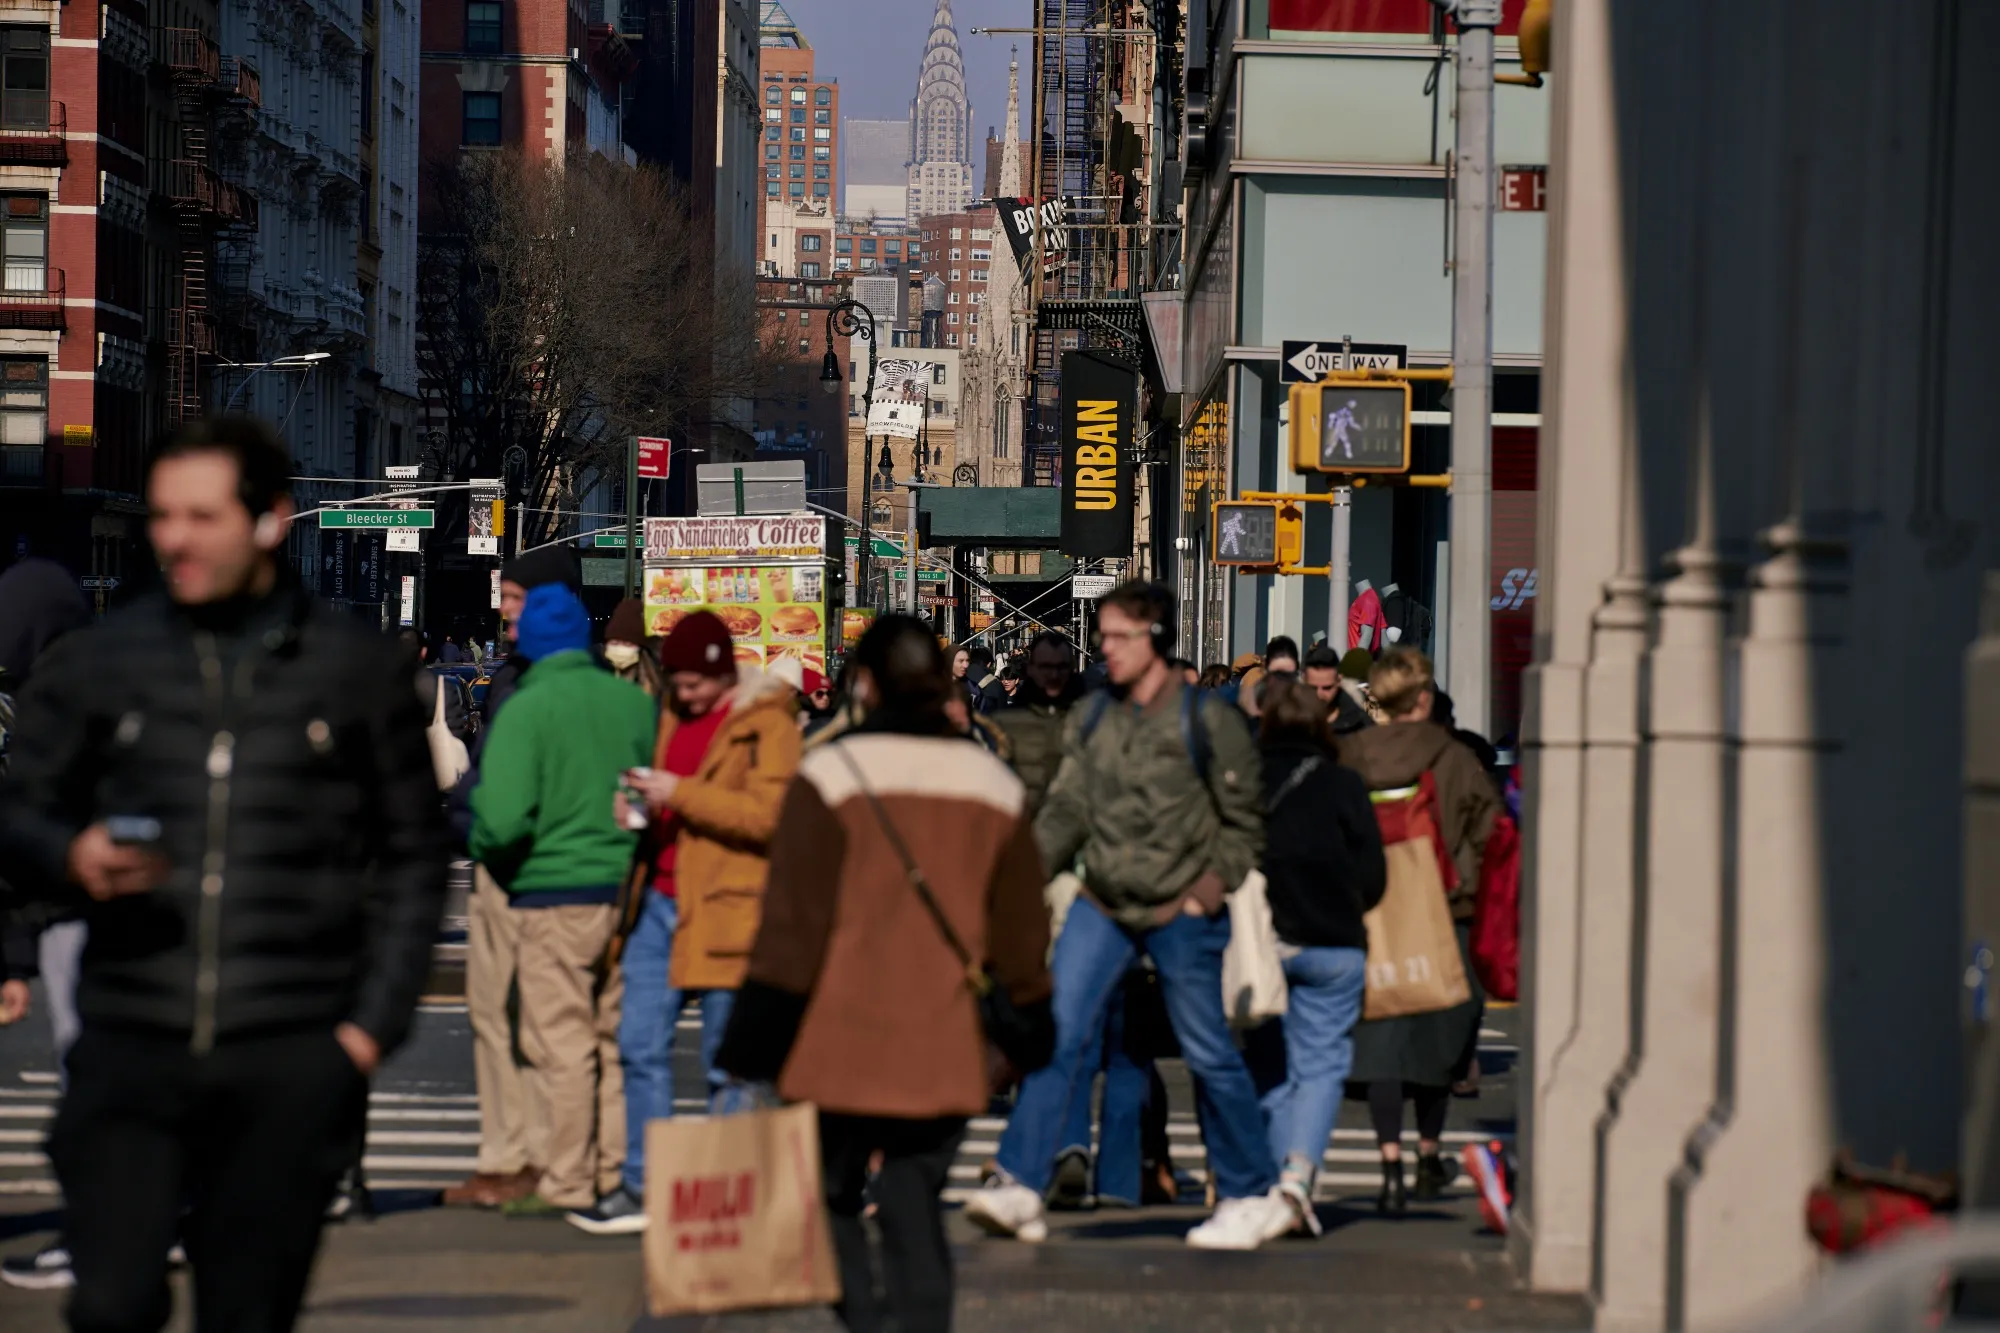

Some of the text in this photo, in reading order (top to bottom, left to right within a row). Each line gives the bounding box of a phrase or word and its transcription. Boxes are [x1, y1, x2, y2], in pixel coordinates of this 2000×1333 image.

[1305, 354, 1389, 370] ONE WAY
[870, 421, 914, 430] SHOWFIELDS
[1075, 400, 1118, 510] URBAN
[346, 513, 408, 524] Bleecker St
[646, 519, 820, 556] Eggs Sandwiches Coffee
[335, 539, 344, 575] SNEAKER
[370, 545, 378, 580] SNEAKER
[335, 577, 343, 595] CITY
[369, 581, 377, 599] CITY
[920, 596, 946, 605] Bleecker
